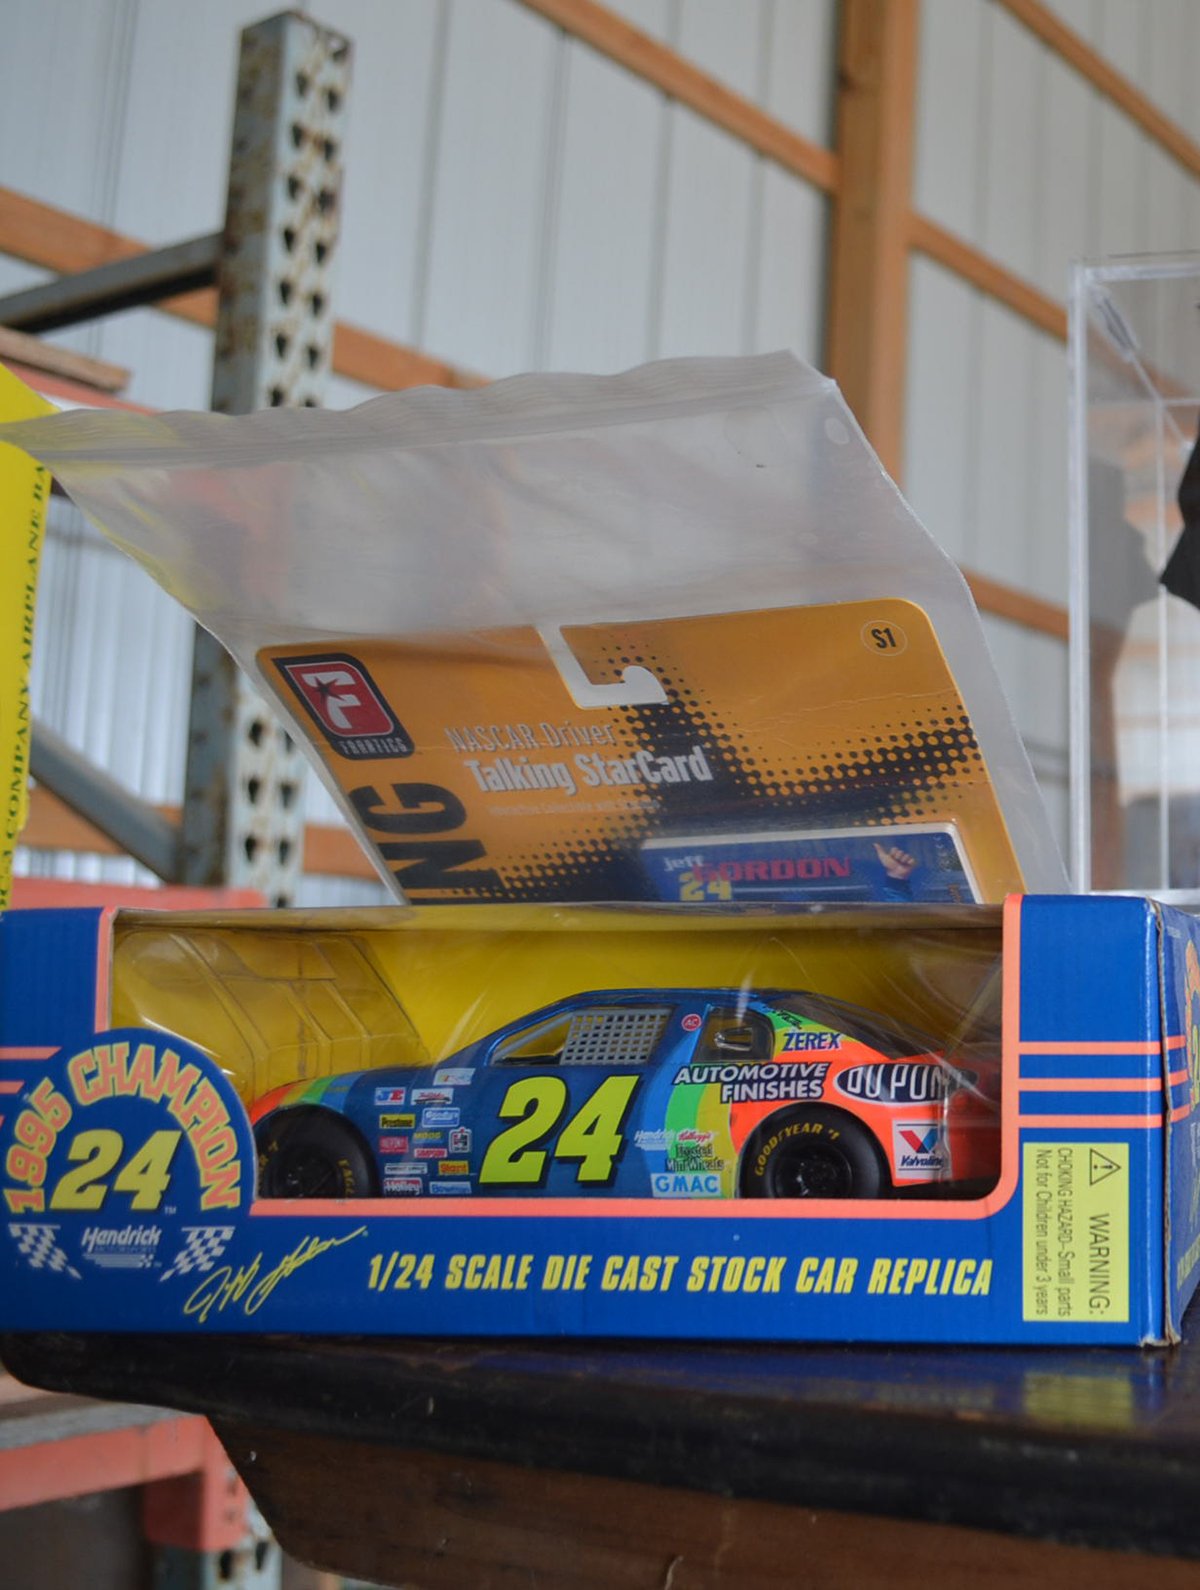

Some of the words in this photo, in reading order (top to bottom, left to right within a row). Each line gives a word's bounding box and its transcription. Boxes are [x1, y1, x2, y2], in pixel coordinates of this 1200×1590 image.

[871, 627, 897, 648] S1
[445, 725, 540, 753] NASCAR
[541, 720, 617, 747] Driver
[464, 757, 578, 796] Talking
[573, 745, 714, 787] StarCard
[679, 872, 733, 901] 24
[782, 1032, 840, 1051] ZEREX
[674, 1063, 830, 1083] AUTOMOTIVE
[722, 1081, 824, 1102] FINISHES
[67, 1041, 241, 1211] CHAMPION
[479, 1075, 641, 1184] 24
[4, 1077, 73, 1214] 1995
[754, 1122, 824, 1176] GOODYEAR
[1036, 1149, 1052, 1169] Not
[50, 1129, 182, 1211] 24
[655, 1175, 719, 1193] GMAC
[1036, 1172, 1053, 1187] for
[1057, 1148, 1073, 1197] CHOKING
[1036, 1191, 1053, 1238] Children
[81, 1225, 162, 1252] Hendrick
[1036, 1240, 1052, 1272] under
[1089, 1213, 1111, 1315] WARNING:
[369, 1251, 434, 1291] 1/24
[445, 1254, 533, 1290] SCALE
[542, 1255, 592, 1290] DIE
[601, 1256, 678, 1291] CAST
[687, 1256, 787, 1293] STOCK
[796, 1257, 858, 1293] CAR
[867, 1258, 993, 1295] REPLICA
[1036, 1275, 1051, 1283] 3
[1033, 1285, 1049, 1316] years
[1055, 1287, 1073, 1316] parts
